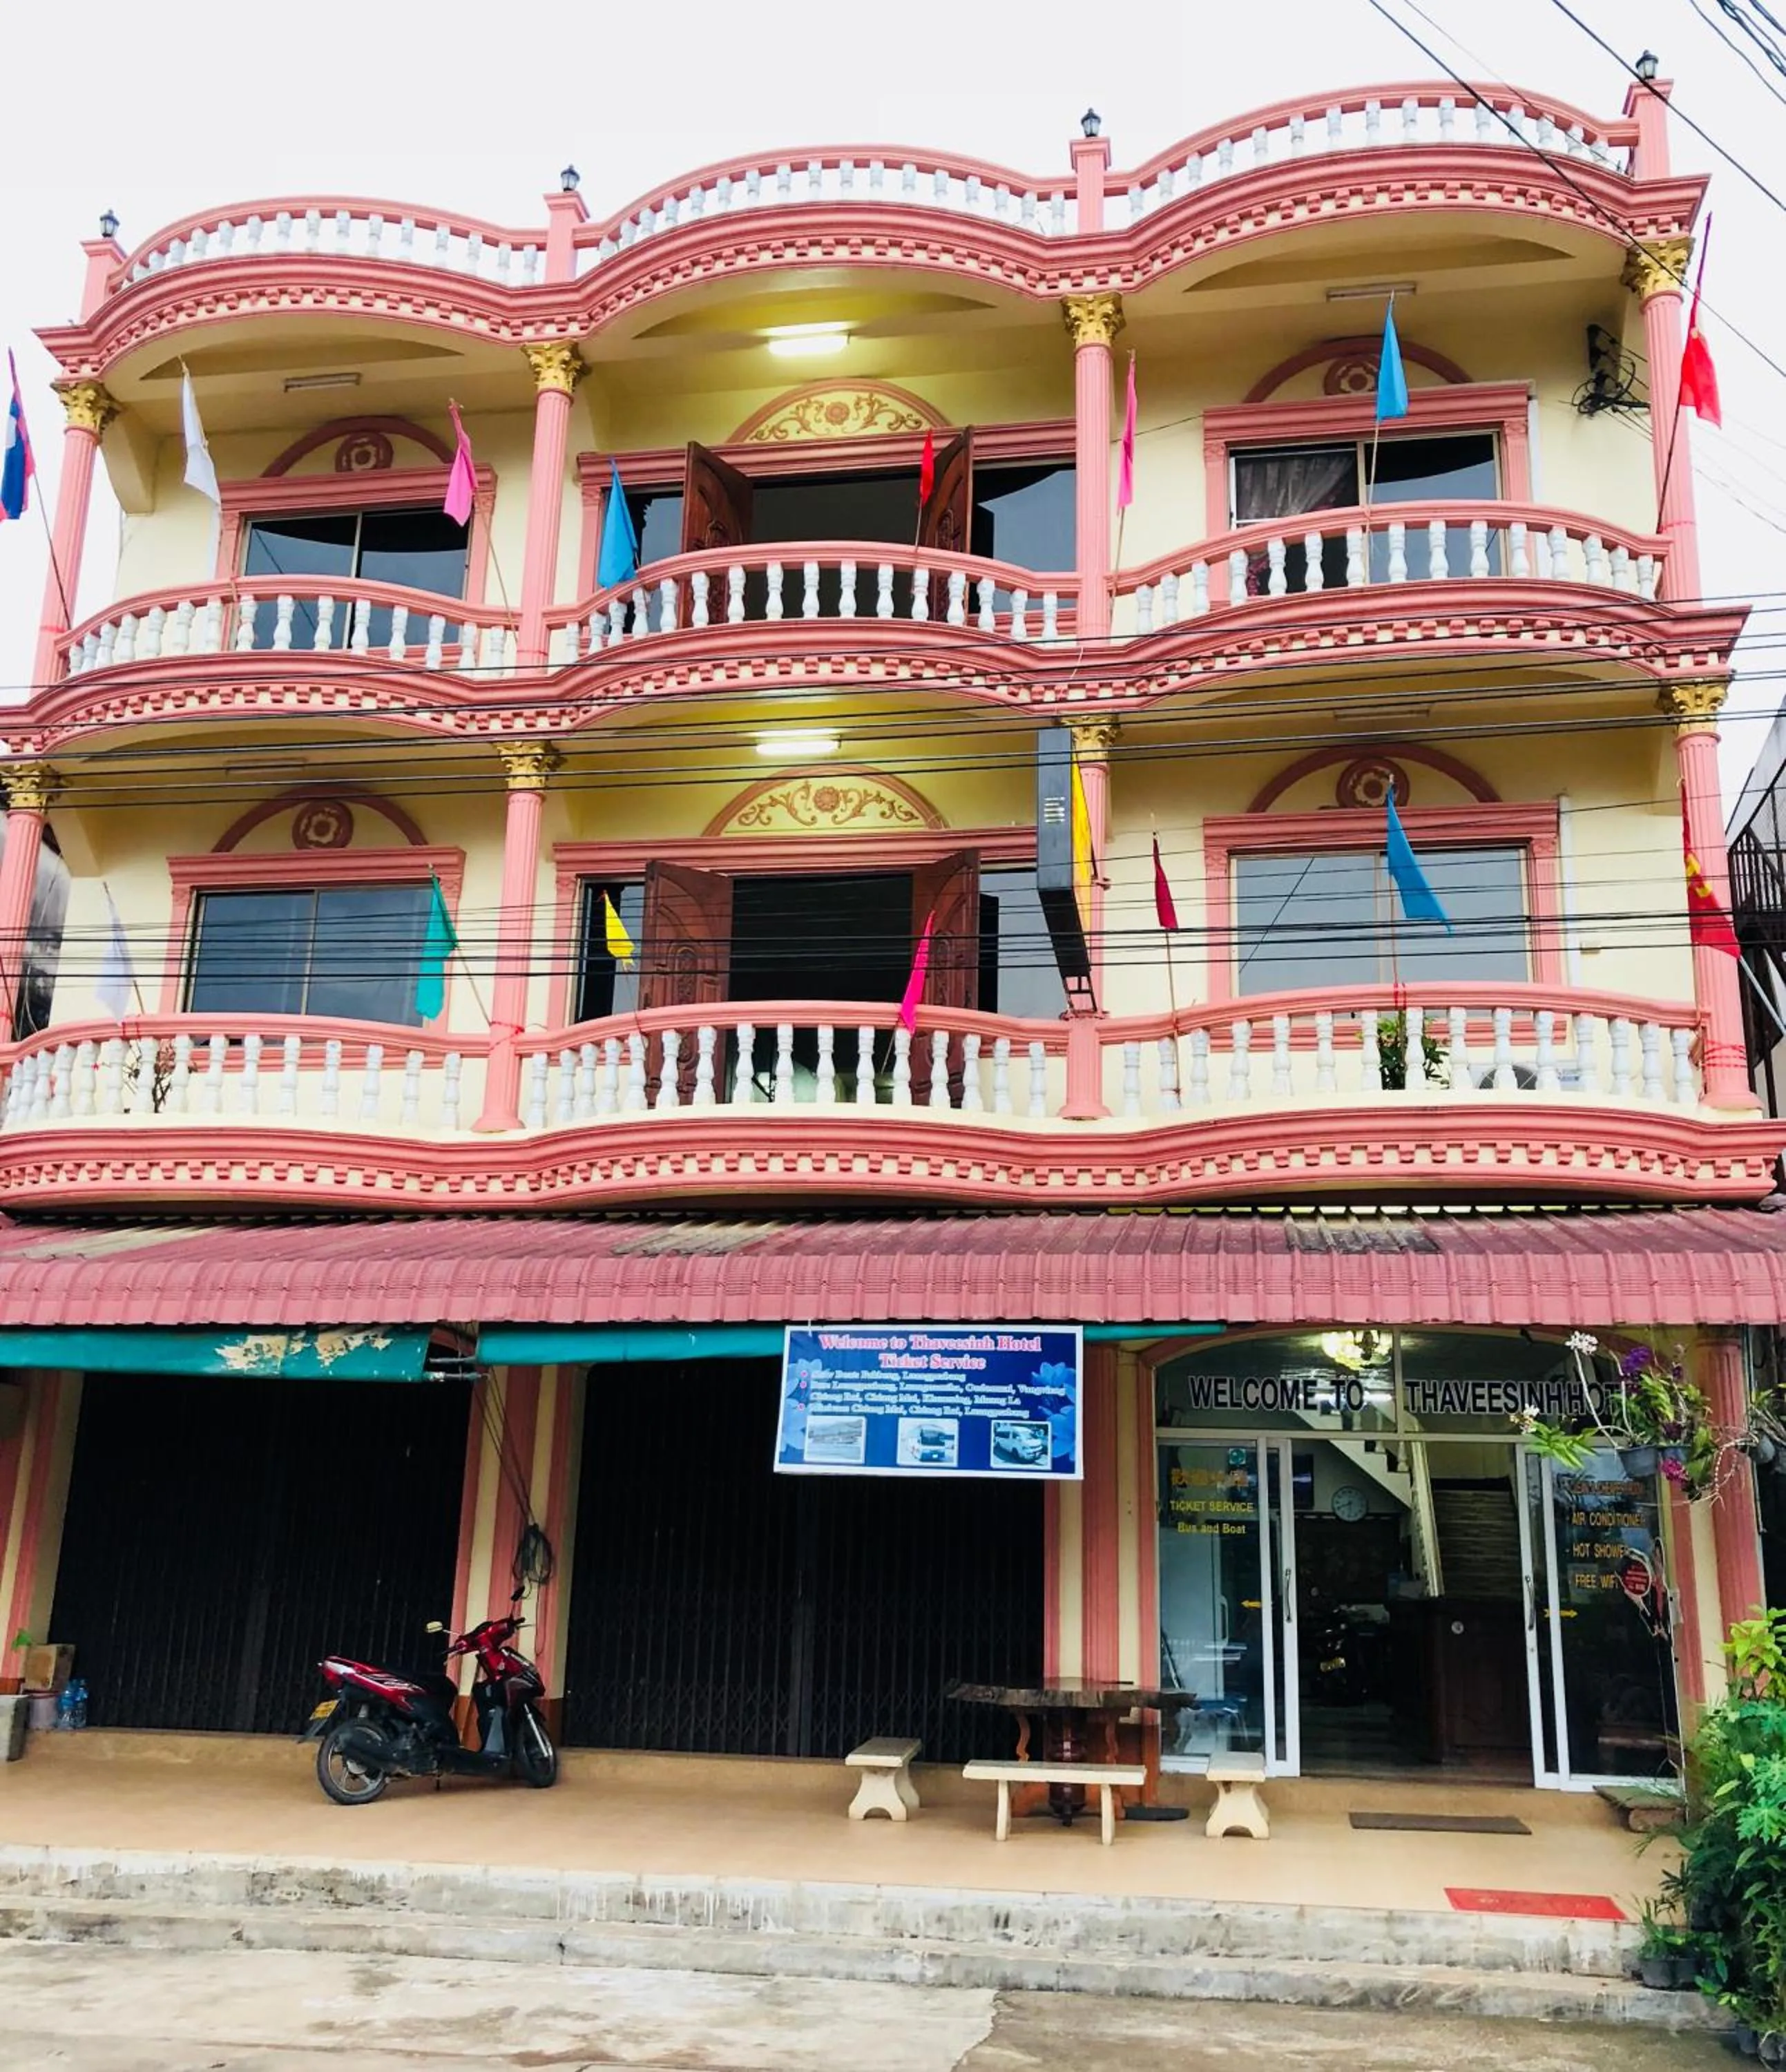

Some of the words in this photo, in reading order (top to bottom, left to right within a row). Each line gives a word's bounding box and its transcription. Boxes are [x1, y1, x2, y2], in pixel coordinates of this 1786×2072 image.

[818, 1334, 887, 1350] Welcome
[890, 1336, 907, 1349] to
[909, 1334, 995, 1351] Thaveesinh
[997, 1335, 1041, 1352] Hotel
[878, 1353, 928, 1368] Ticket
[930, 1353, 987, 1370] Service
[1189, 1375, 1318, 1410] WELCOME
[1329, 1377, 1366, 1411] TO
[1404, 1379, 1563, 1414] THAVEESINH
[1566, 1380, 1630, 1416] HOT
[1170, 1500, 1206, 1512] TICKET
[1209, 1500, 1254, 1513] SERVICE
[1572, 1512, 1586, 1525] AIR
[1178, 1522, 1197, 1533] Bus
[1200, 1523, 1220, 1533] and
[1222, 1523, 1246, 1534] Boat
[1573, 1543, 1591, 1557] HOT
[1575, 1574, 1596, 1589] FREE
